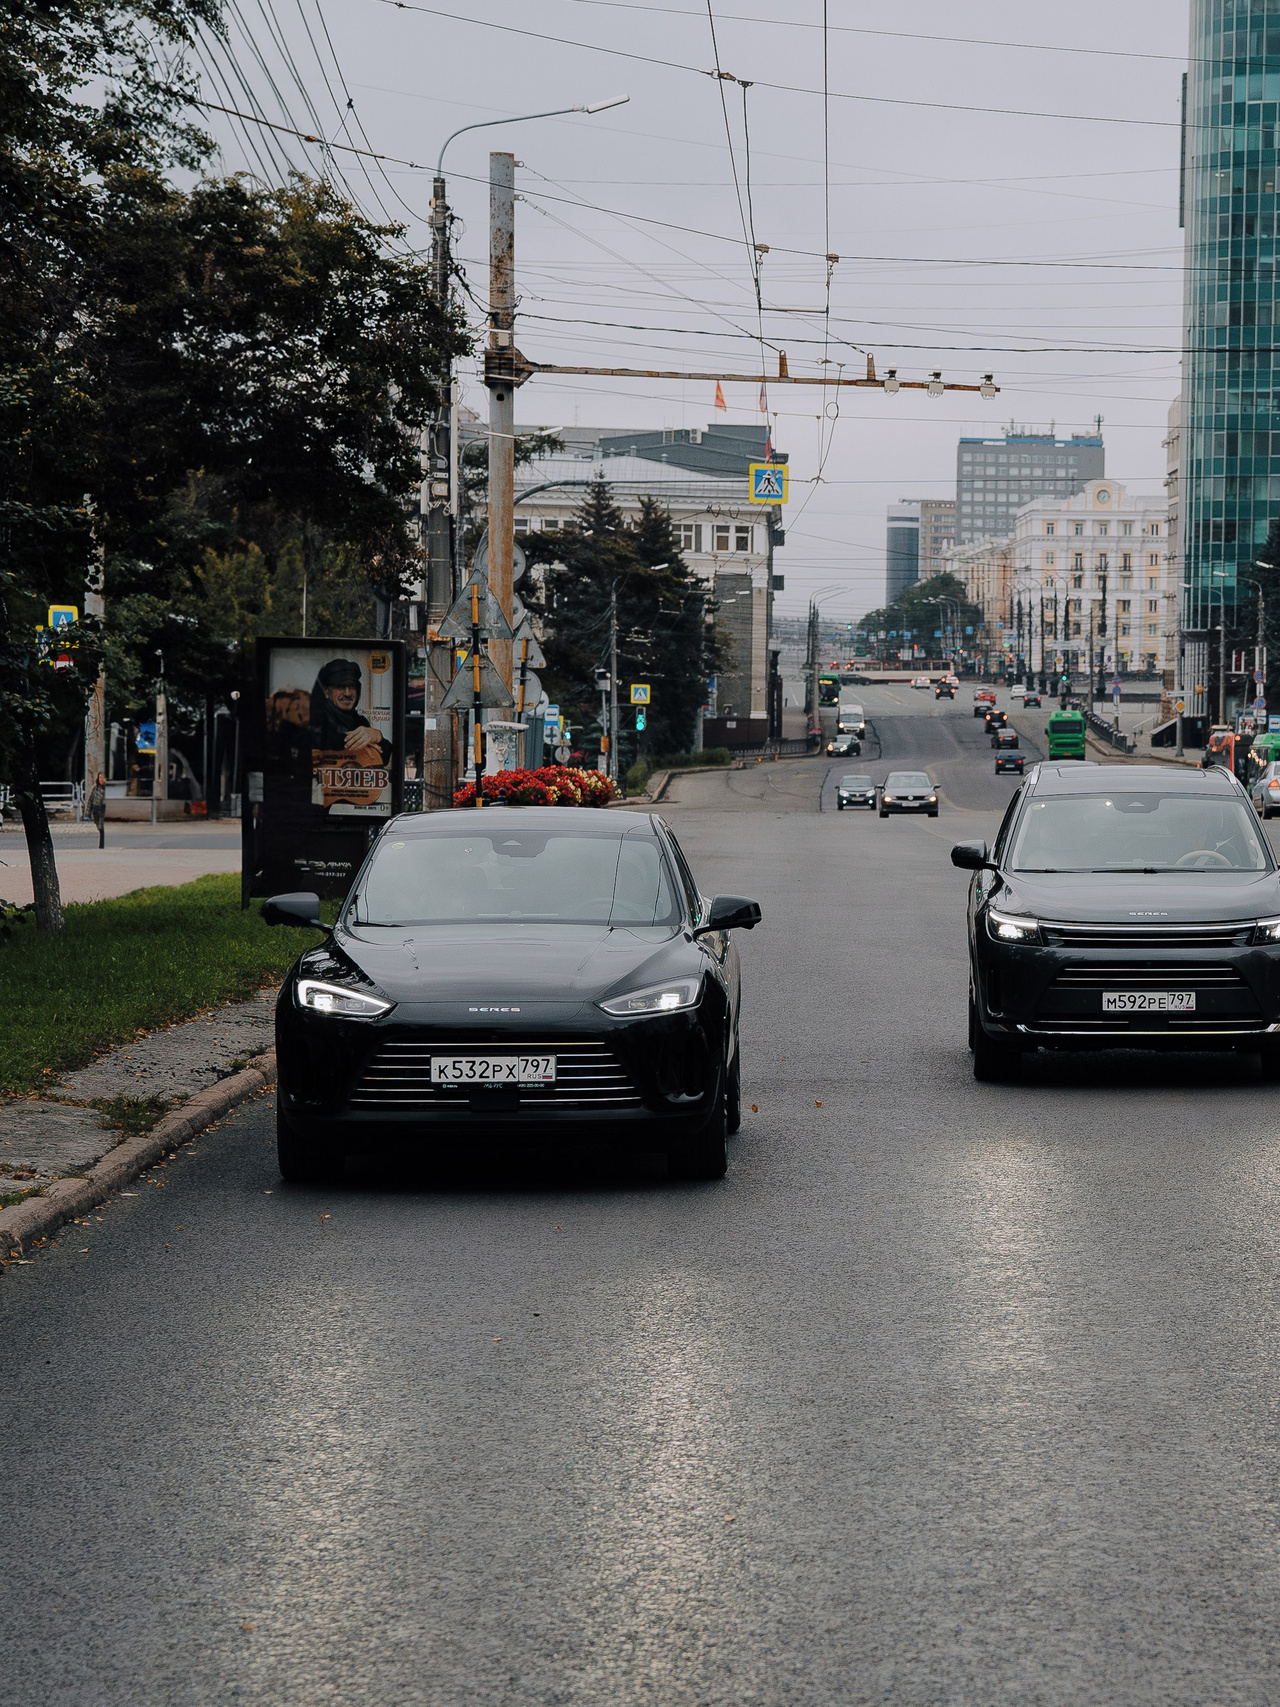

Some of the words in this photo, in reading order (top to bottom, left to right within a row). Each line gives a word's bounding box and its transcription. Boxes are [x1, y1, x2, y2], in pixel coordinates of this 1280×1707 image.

[1106, 994, 1167, 1009] М592РЕ
[1169, 993, 1193, 1005] 797
[438, 1060, 517, 1079] К532РХ
[520, 1058, 551, 1074] 797
